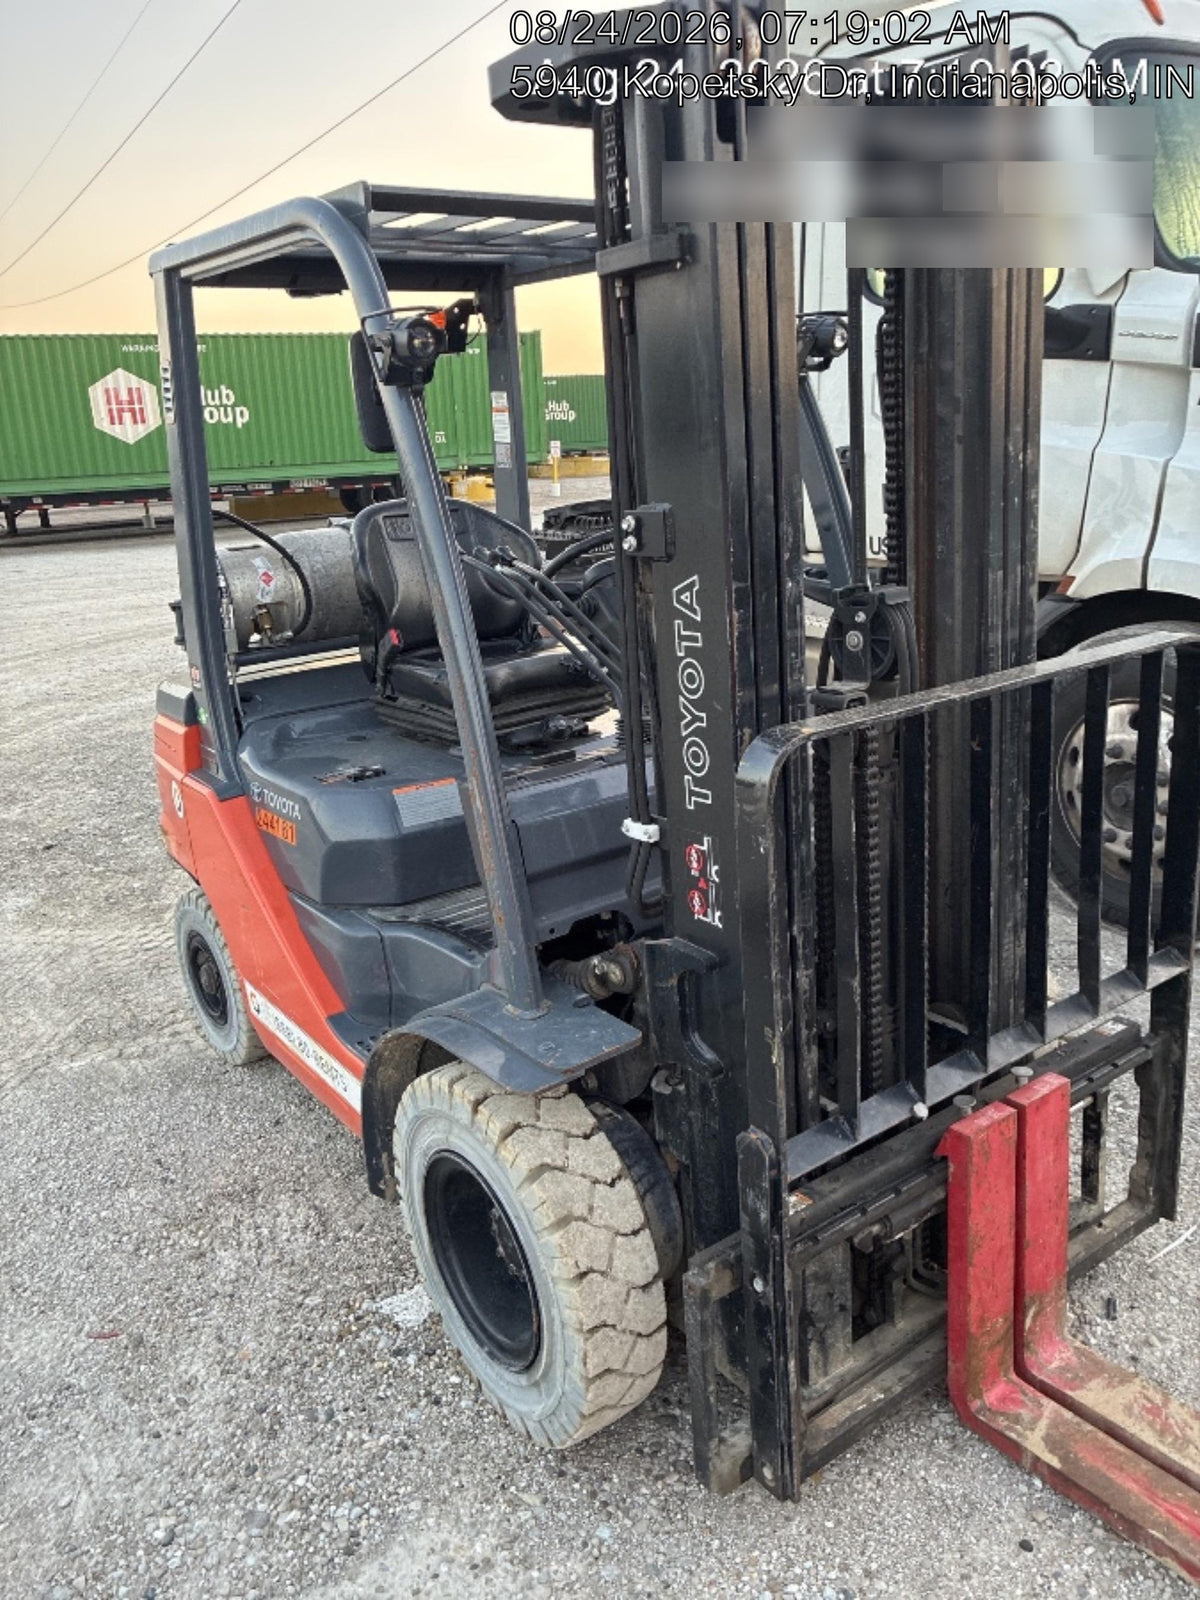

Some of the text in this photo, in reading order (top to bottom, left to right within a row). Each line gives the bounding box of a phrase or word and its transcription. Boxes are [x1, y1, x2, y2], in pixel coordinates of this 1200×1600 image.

[203, 405, 250, 429] oup
[548, 400, 570, 411] Hub
[672, 574, 713, 810] TOYOTA
[263, 788, 302, 821] TOYOTA
